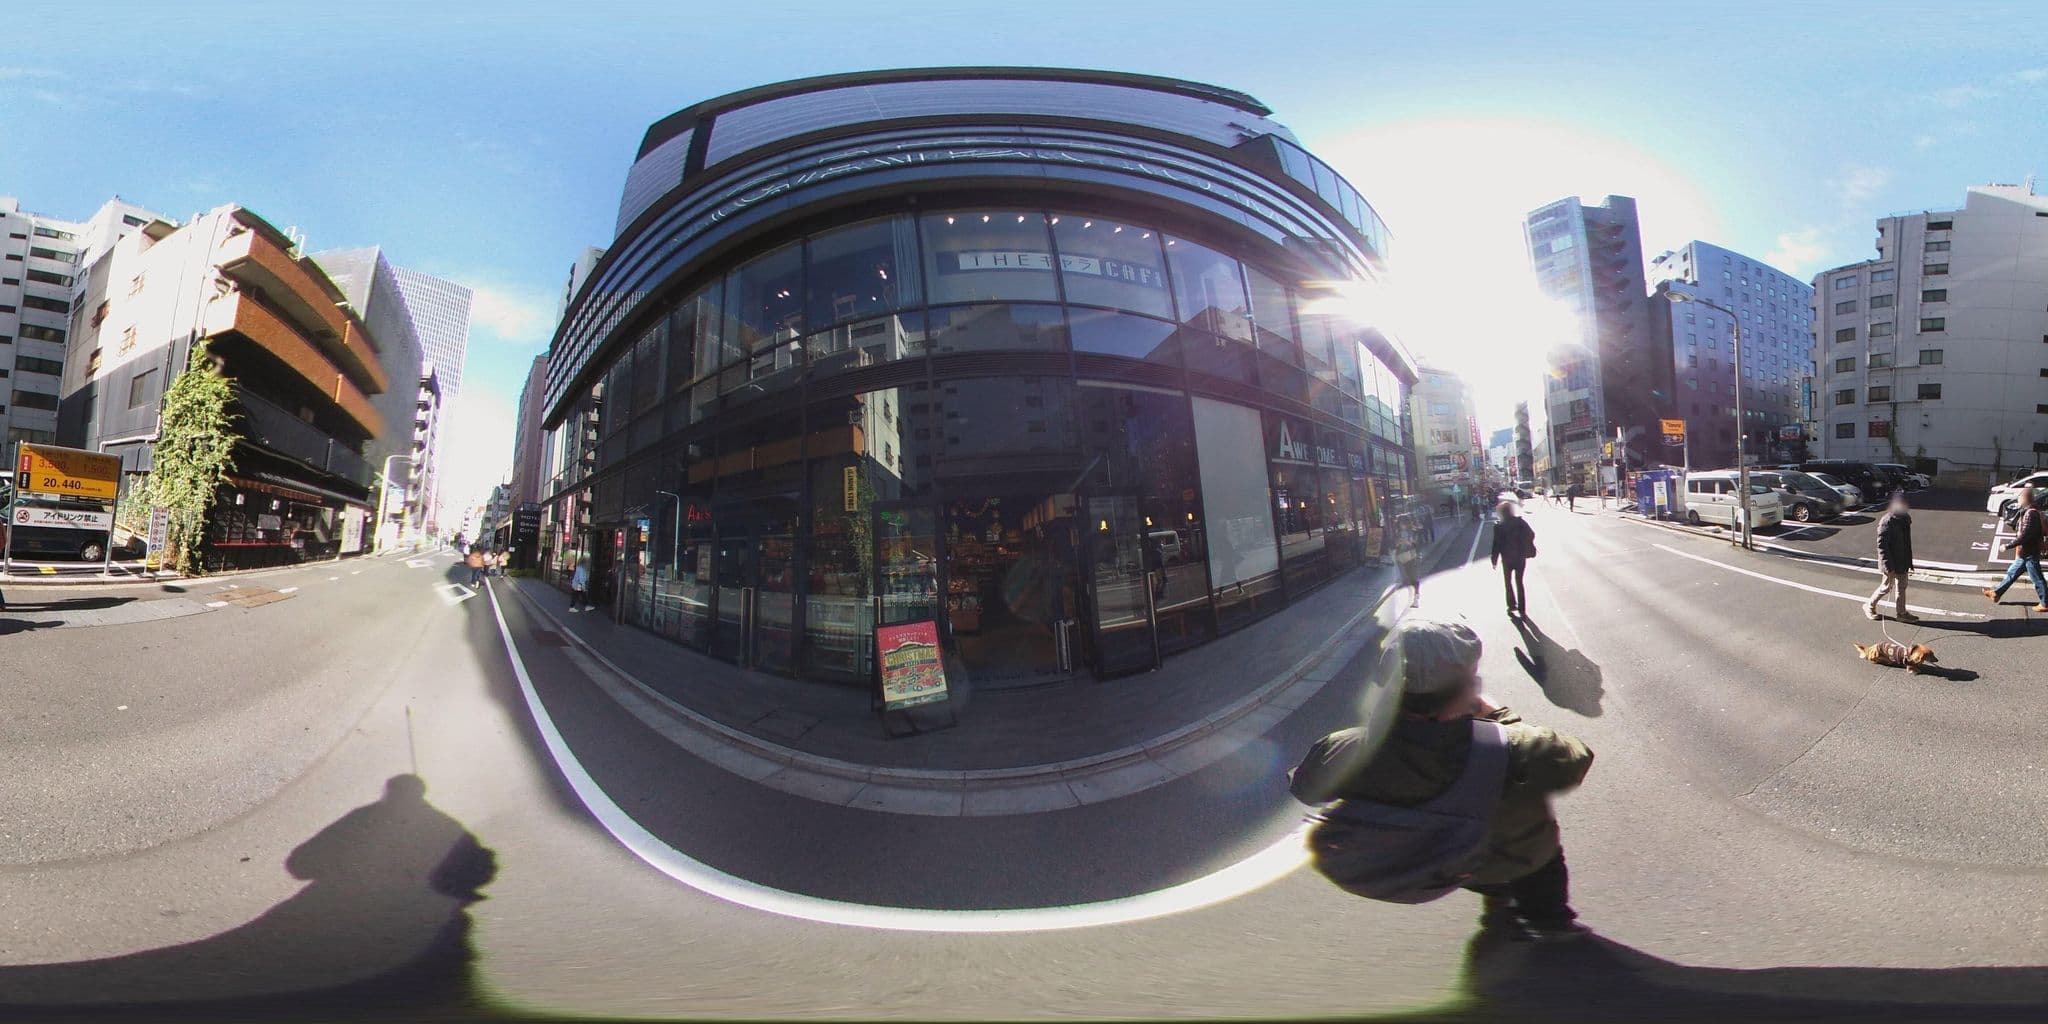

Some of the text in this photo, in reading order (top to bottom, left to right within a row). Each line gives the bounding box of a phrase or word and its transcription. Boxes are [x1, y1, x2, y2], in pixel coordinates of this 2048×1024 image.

[973, 254, 1029, 267] THE
[43, 511, 98, 523] アイドリング禁止
[886, 647, 937, 666] CHRISTMAS
